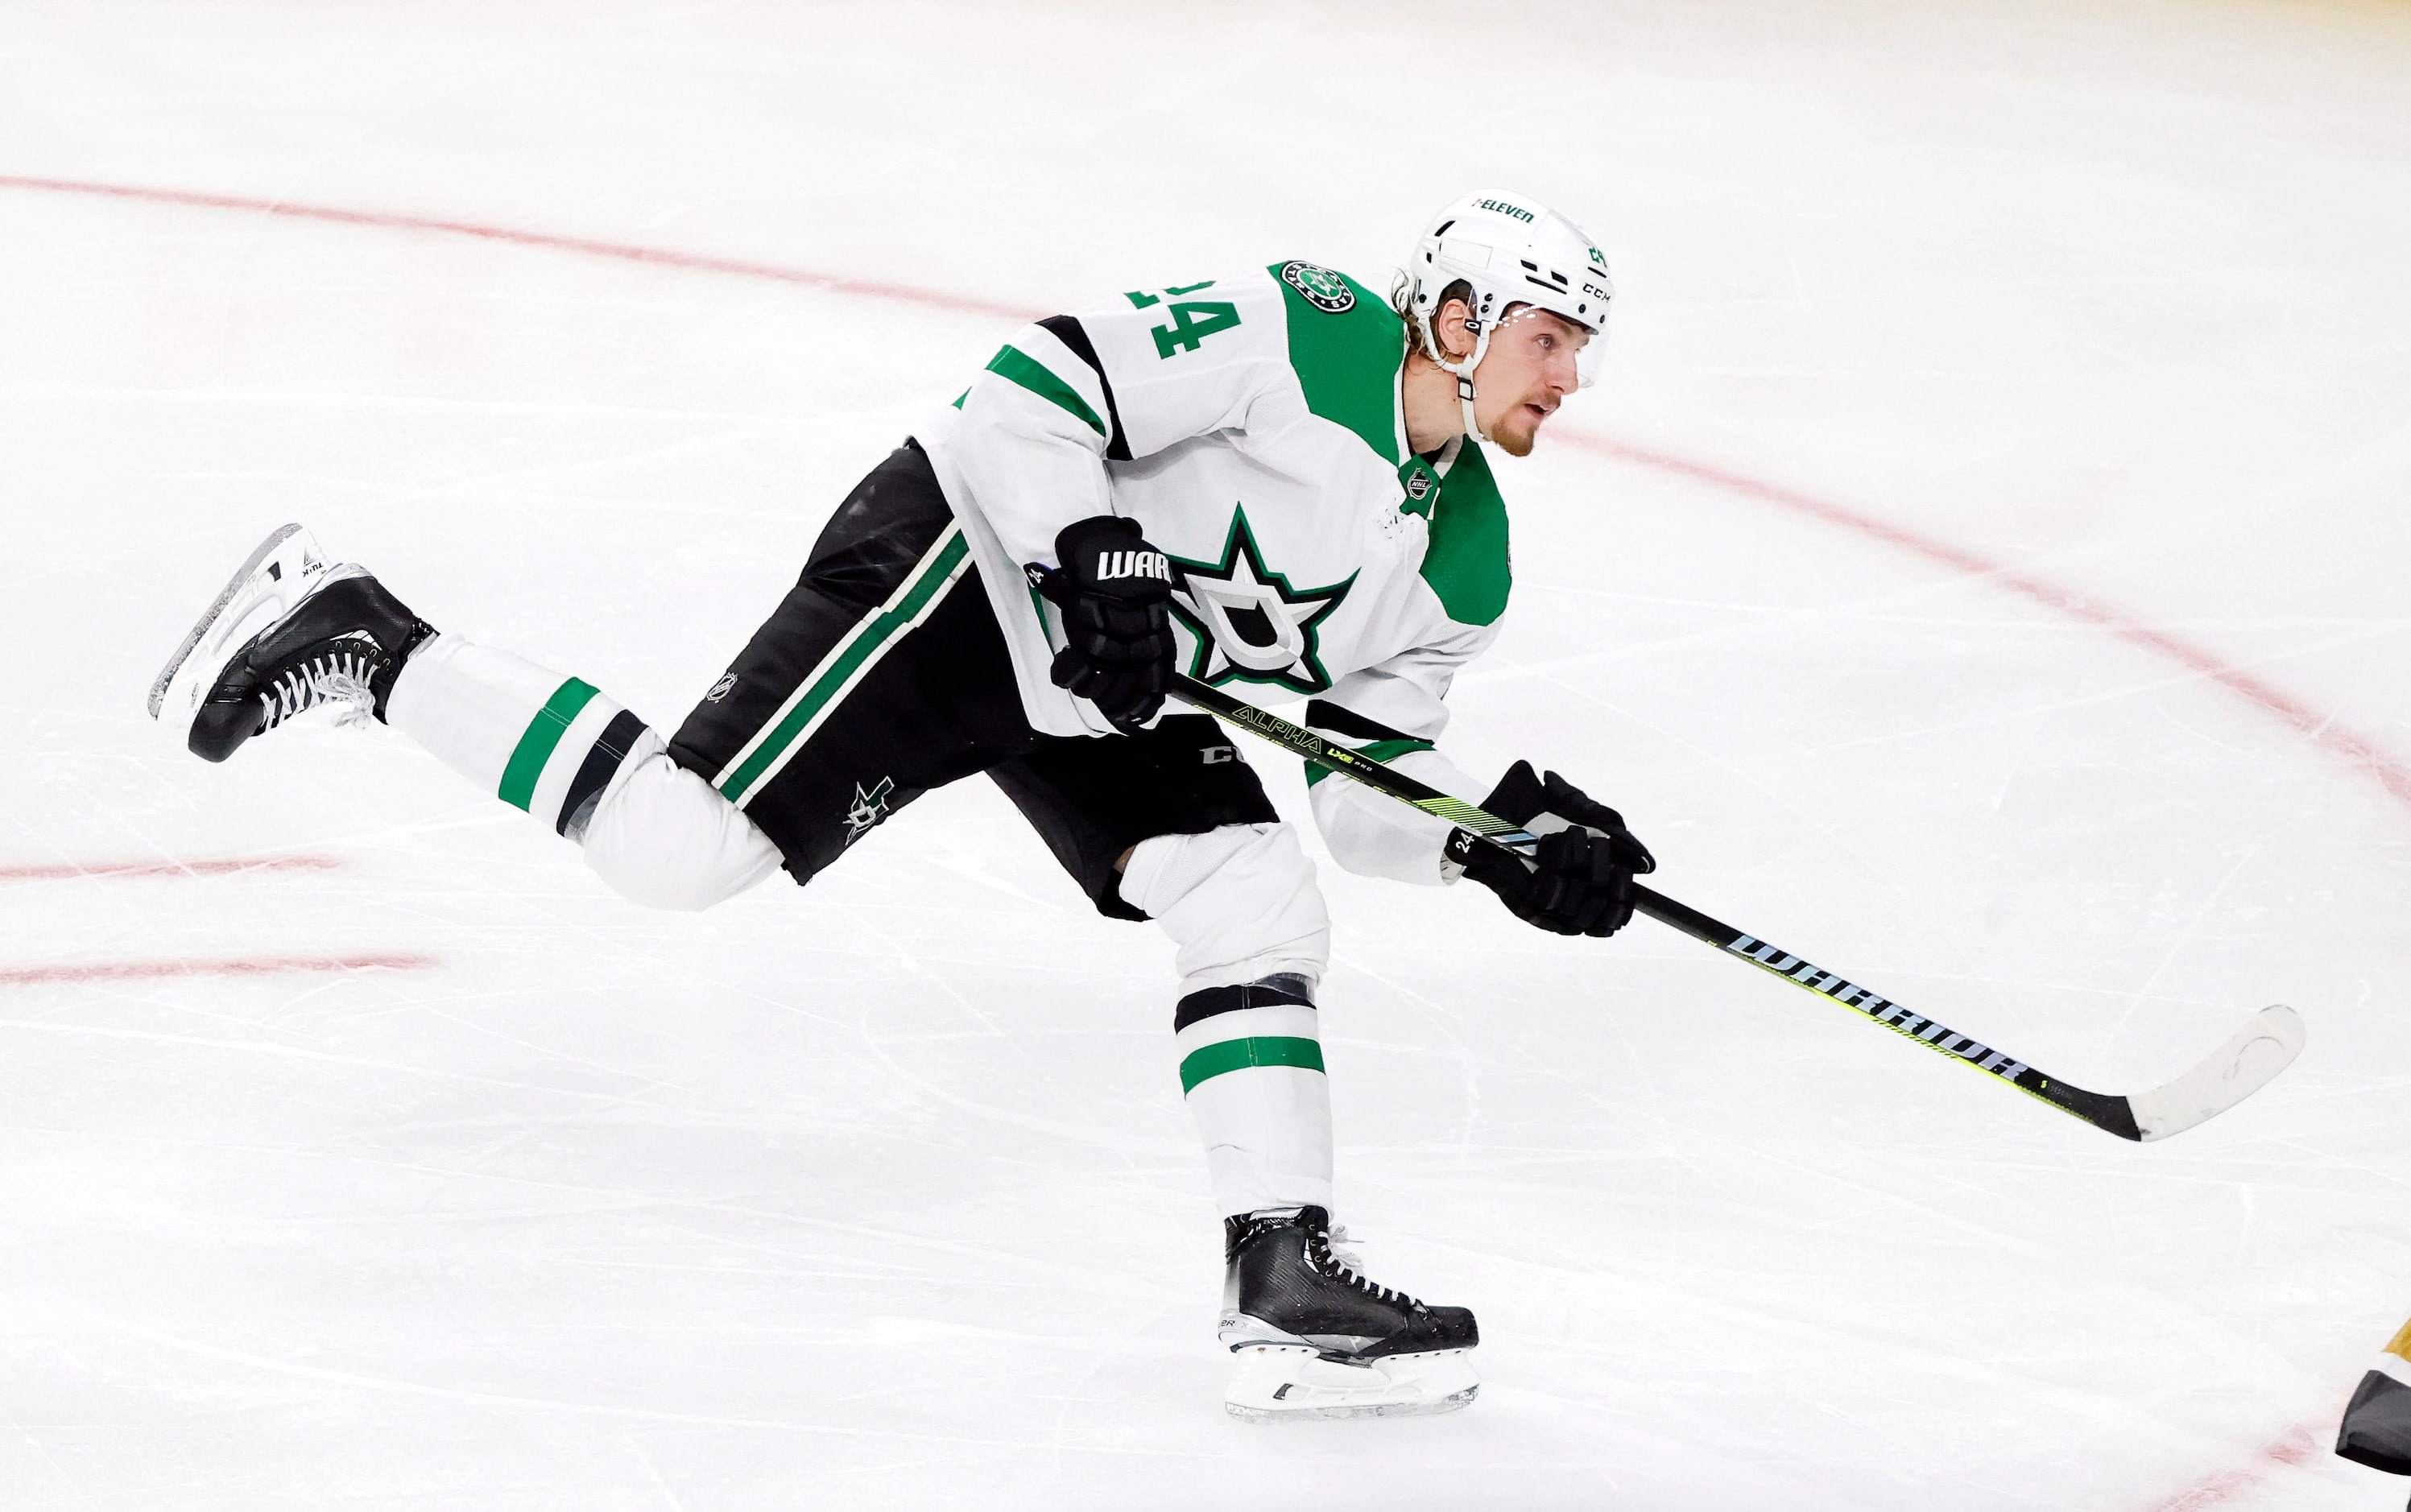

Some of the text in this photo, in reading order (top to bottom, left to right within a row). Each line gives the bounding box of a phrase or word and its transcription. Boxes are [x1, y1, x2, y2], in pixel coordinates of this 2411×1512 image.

[1582, 282, 1611, 303] CCM
[1232, 705, 1322, 755] ALPHA
[1354, 761, 1373, 772] PRO
[1455, 832, 1474, 853] 24
[1727, 934, 2028, 1082] WARRIOR
